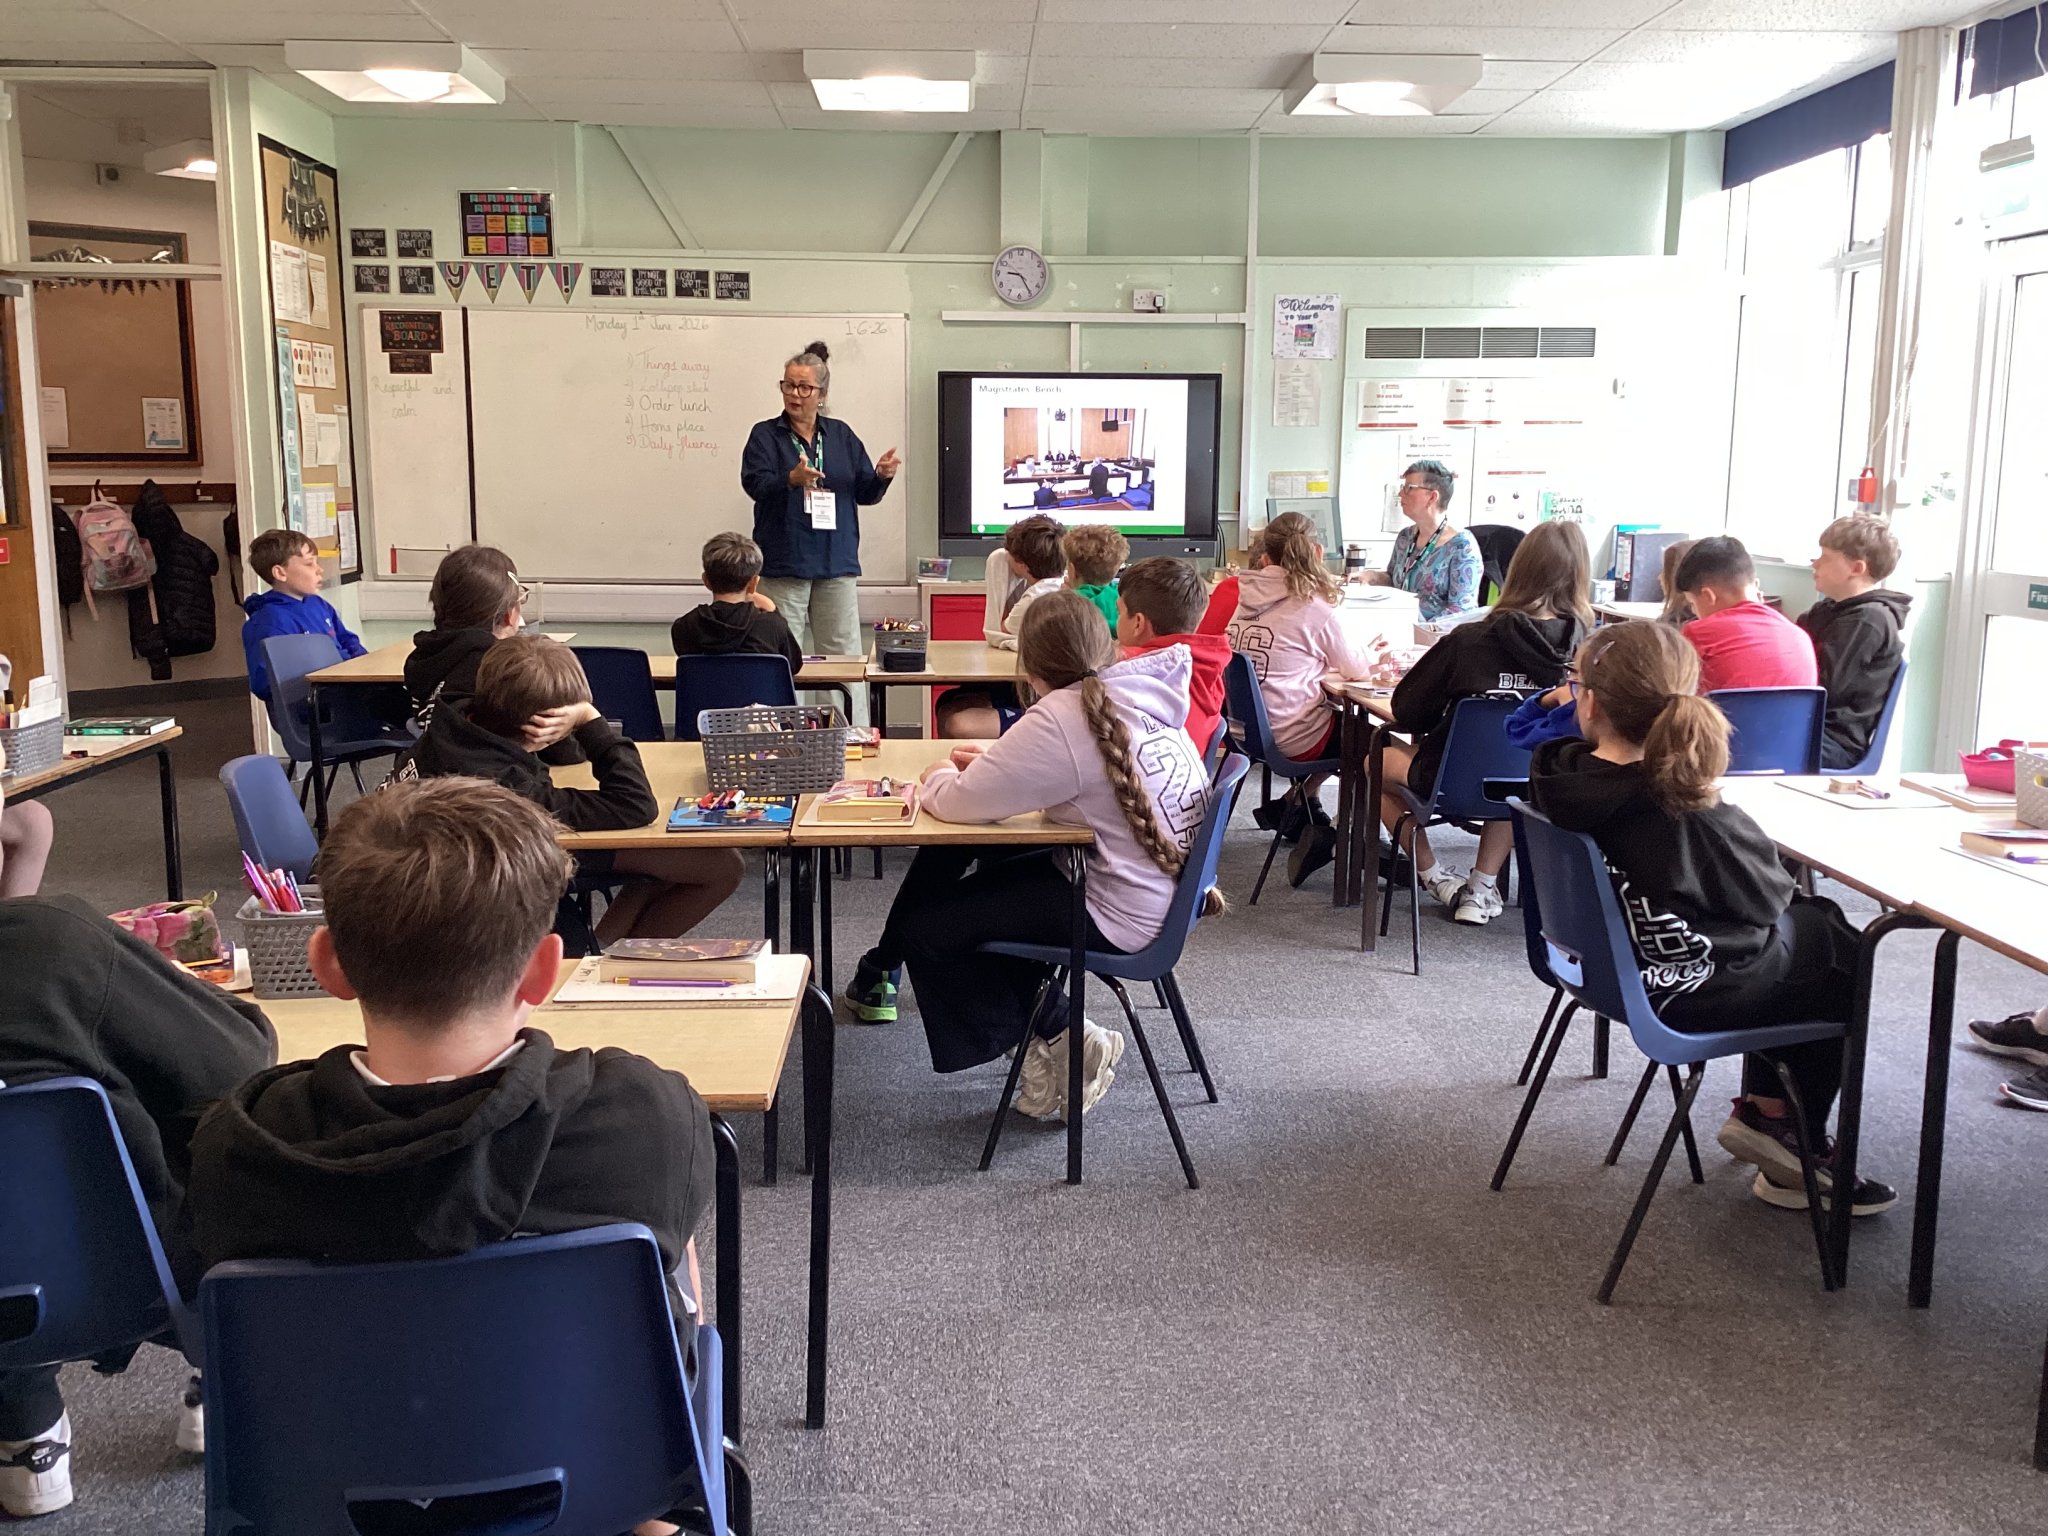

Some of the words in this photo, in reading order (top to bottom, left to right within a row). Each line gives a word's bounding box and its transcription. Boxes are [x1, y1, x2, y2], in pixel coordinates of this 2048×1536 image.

[291, 158, 314, 186] Our
[286, 192, 326, 229] Class
[447, 264, 570, 293] YET!
[384, 322, 434, 331] RECOGNITION
[393, 331, 428, 341] BOARD
[585, 314, 628, 340] Monday
[650, 314, 673, 331] June
[678, 317, 710, 331] 2026
[636, 346, 679, 379] Things
[681, 362, 710, 380] away
[371, 376, 421, 399] Respectful
[433, 380, 456, 395] and
[1035, 385, 1062, 393] Bench
[391, 403, 417, 418] calm
[639, 394, 674, 412] Order
[680, 398, 712, 413] lunch
[640, 413, 672, 434] Home
[676, 420, 704, 440] place
[638, 433, 672, 459] Daily
[676, 434, 720, 460] fluency
